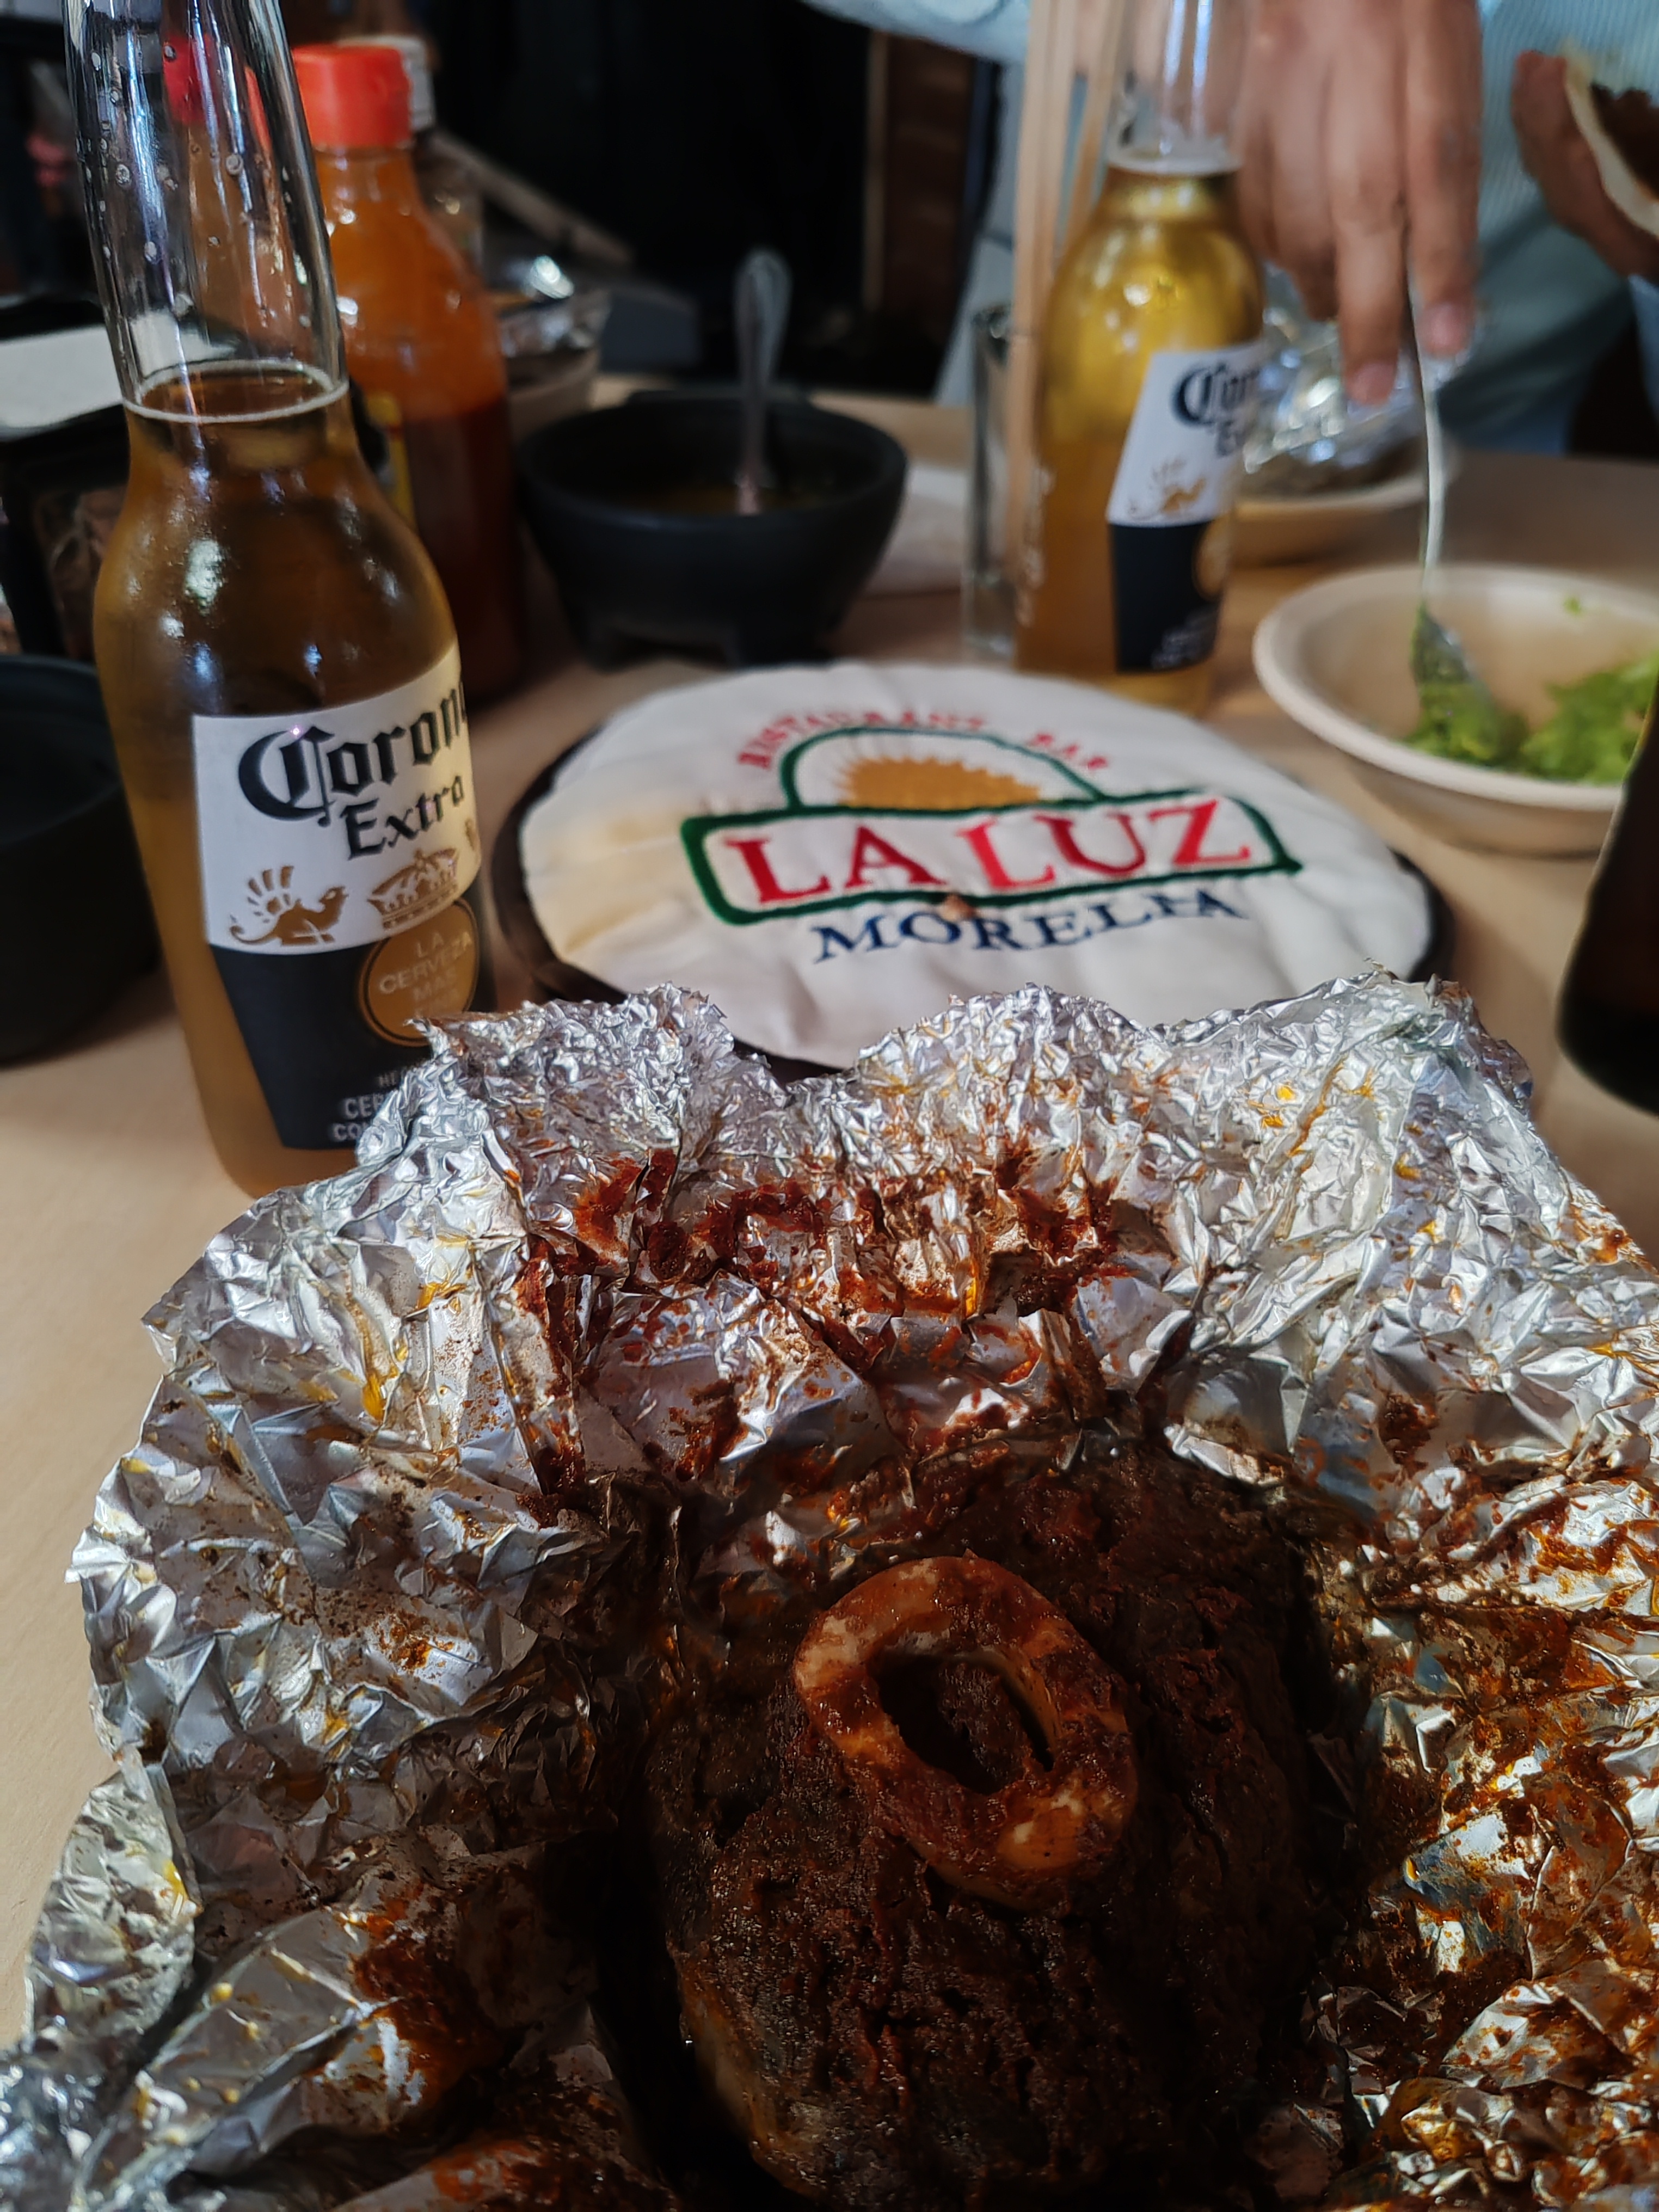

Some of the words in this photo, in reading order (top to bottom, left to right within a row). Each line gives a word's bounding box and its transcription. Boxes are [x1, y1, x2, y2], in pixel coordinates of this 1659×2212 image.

[339, 775, 464, 860] Extra
[726, 826, 948, 904] LA
[958, 799, 1251, 890] LUZ
[809, 887, 1250, 964] MORELIA
